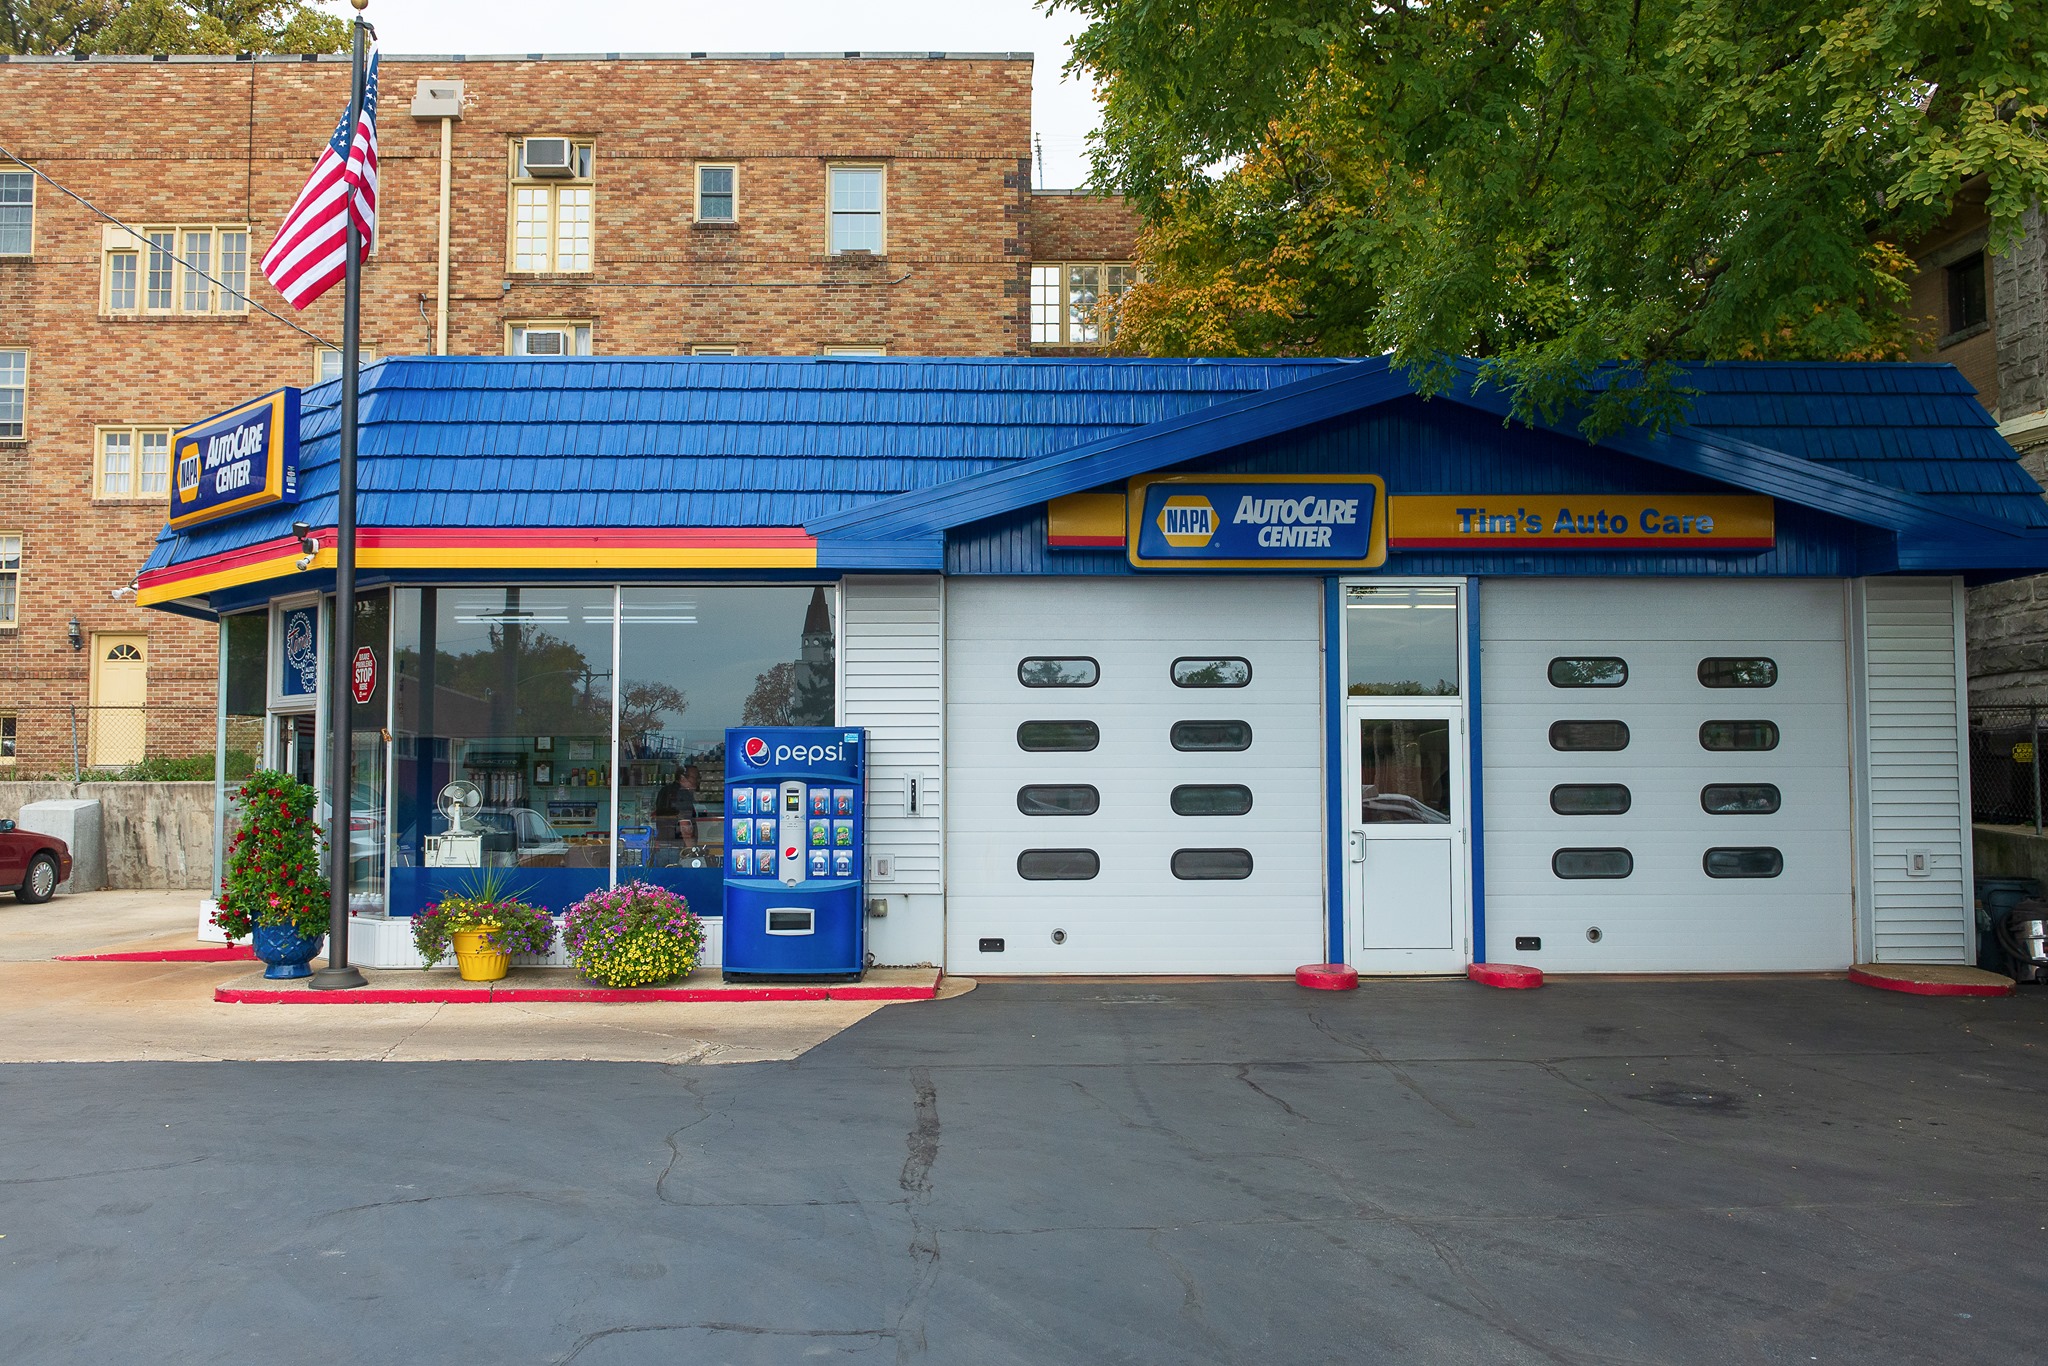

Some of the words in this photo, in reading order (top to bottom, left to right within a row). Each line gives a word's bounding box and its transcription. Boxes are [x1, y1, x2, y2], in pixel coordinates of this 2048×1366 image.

[180, 454, 199, 490] NAPA
[215, 459, 251, 494] CENTER
[1166, 509, 1210, 534] NAPA
[1455, 508, 1543, 534] Tim's
[1553, 508, 1629, 534] Auto
[1639, 508, 1715, 534] Care
[1258, 526, 1333, 548] CENTER
[355, 667, 373, 684] STOP
[775, 741, 844, 766] pepsi
